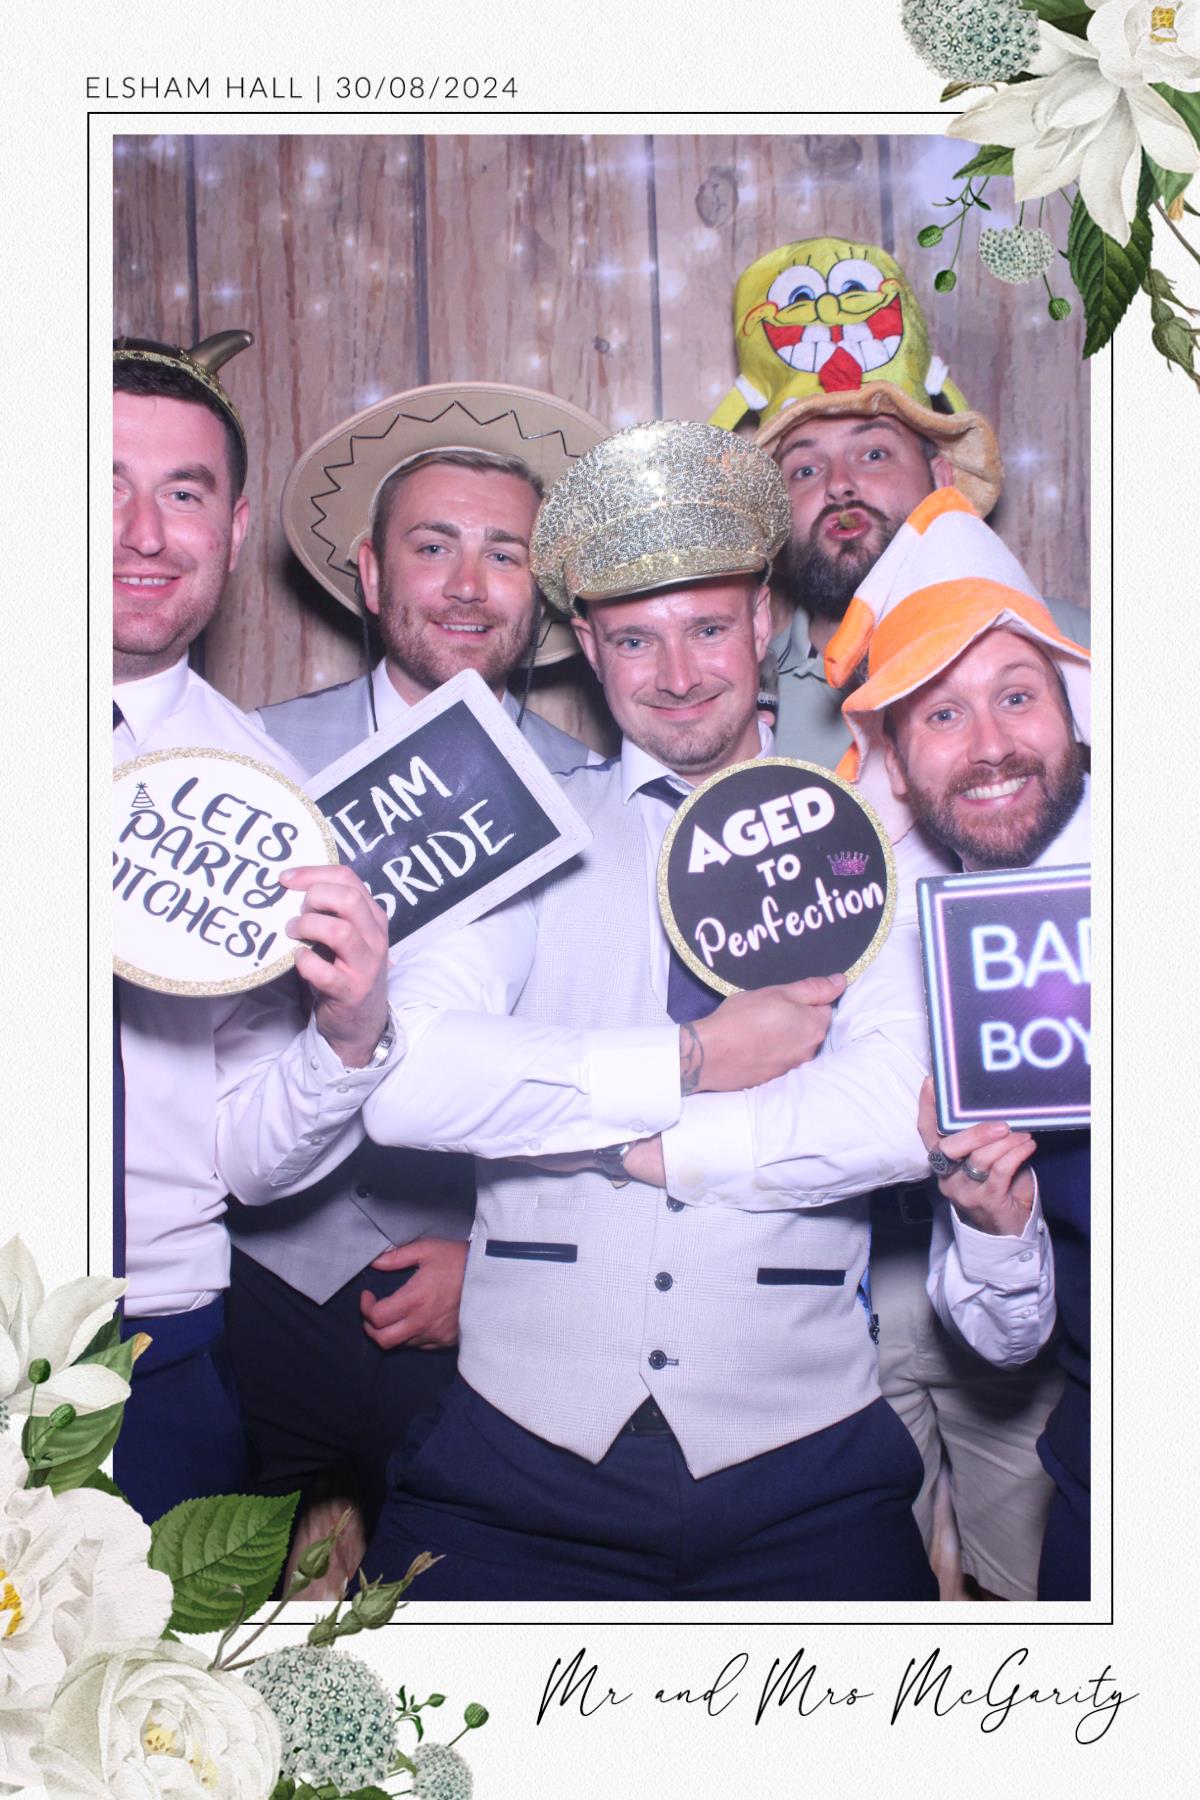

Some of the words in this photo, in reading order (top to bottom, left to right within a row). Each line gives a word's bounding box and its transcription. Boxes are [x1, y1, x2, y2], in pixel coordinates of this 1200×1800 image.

[119, 809, 289, 909] PARTY
[171, 777, 299, 862] LETS
[687, 786, 835, 874] AGED
[112, 851, 278, 967] ITCHES!
[755, 853, 801, 888] TO
[694, 877, 884, 968] Perfection
